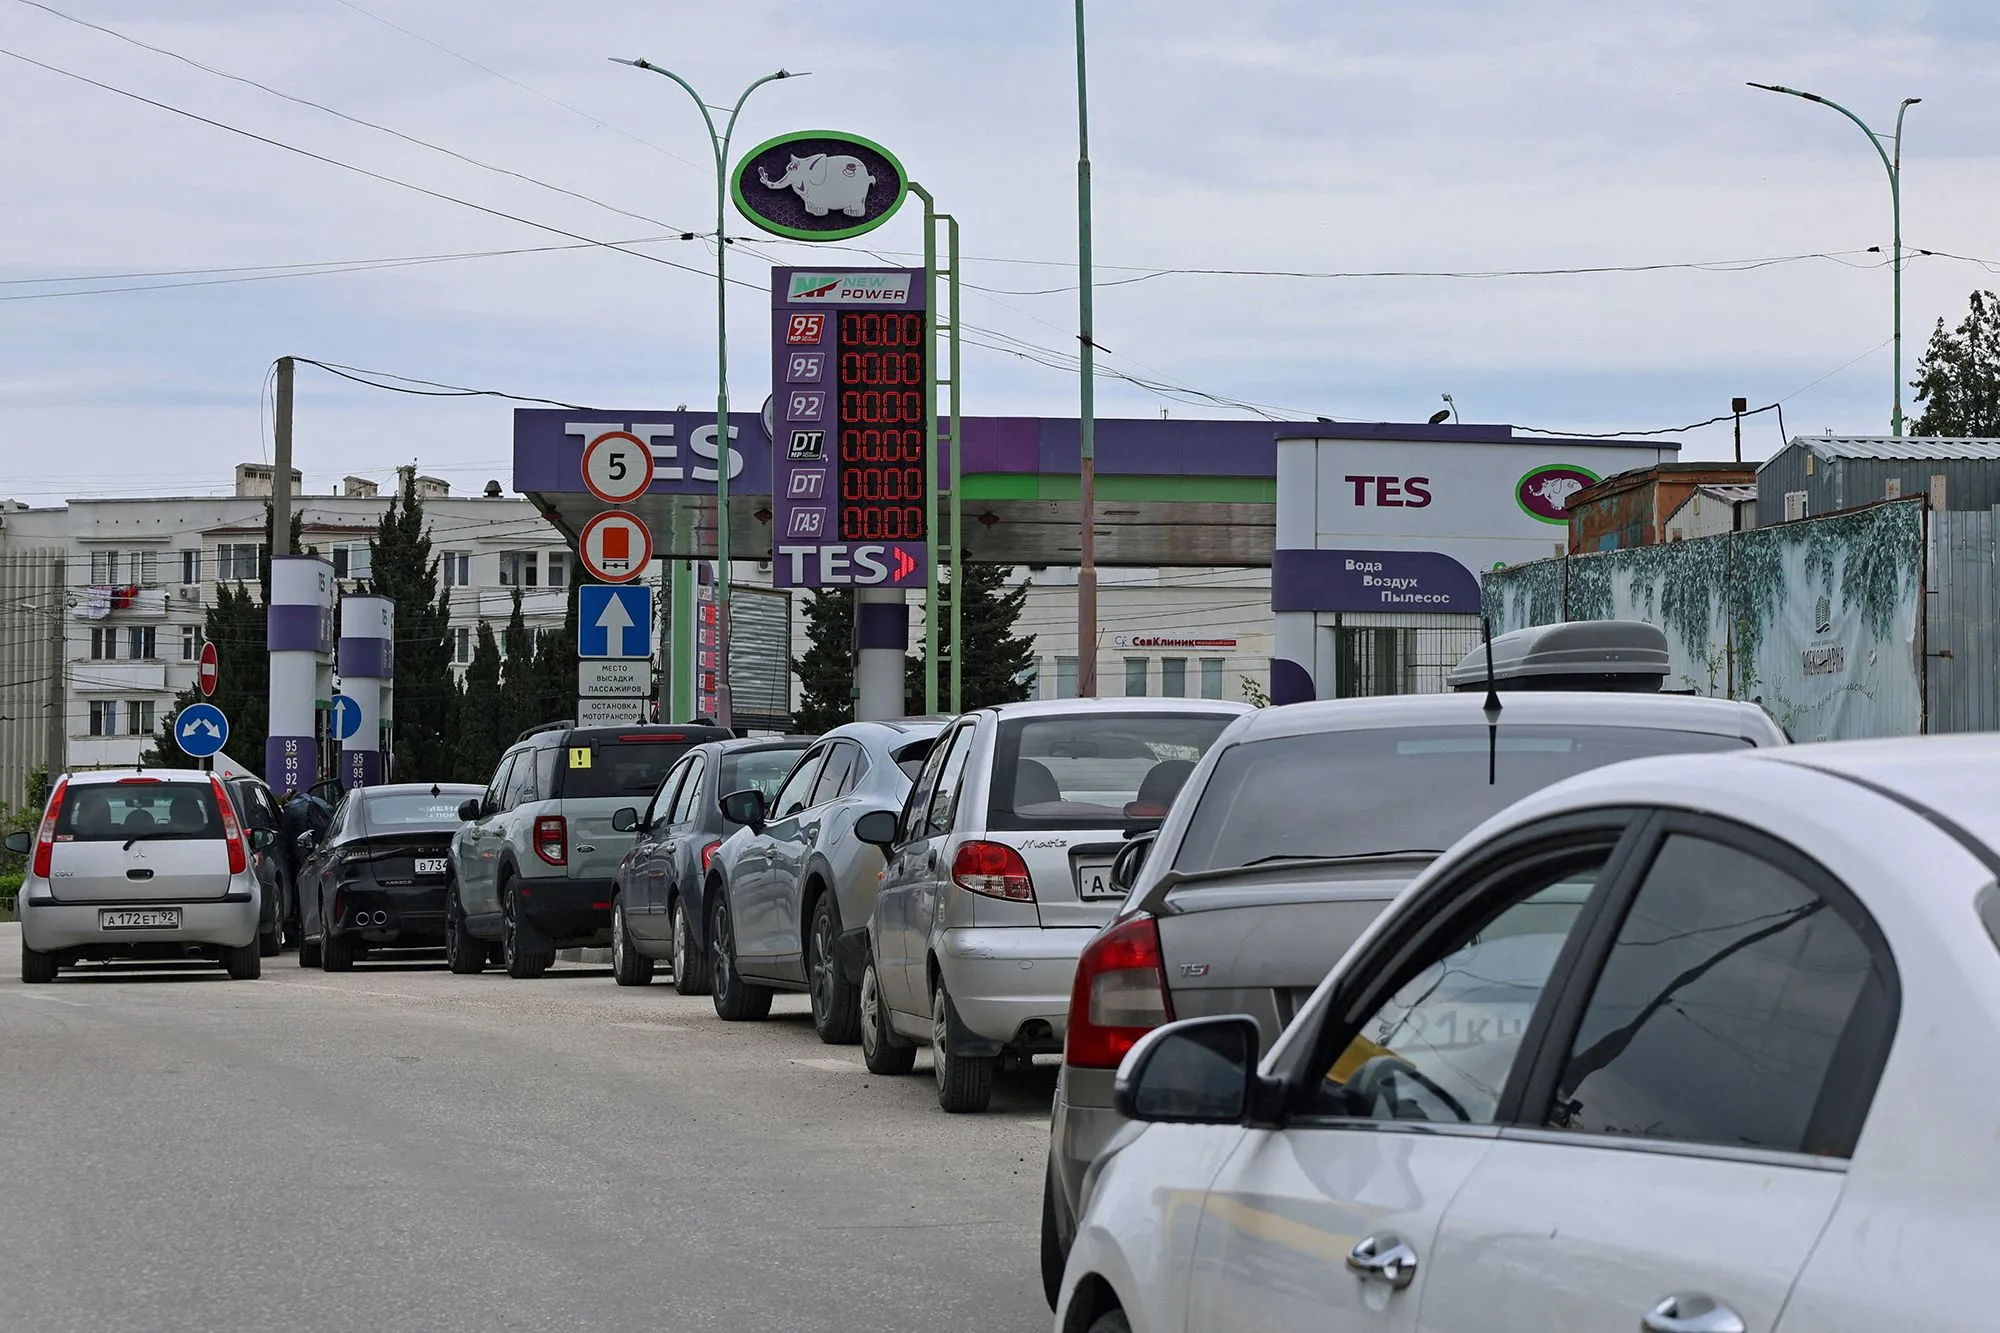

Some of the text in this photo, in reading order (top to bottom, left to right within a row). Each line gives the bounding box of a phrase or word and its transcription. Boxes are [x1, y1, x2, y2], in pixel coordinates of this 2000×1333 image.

[844, 277, 885, 287] NEW
[841, 290, 905, 299] POWER
[793, 317, 819, 336] 95
[793, 358, 819, 377] 95
[793, 397, 819, 415] 92
[792, 433, 821, 451] DT
[565, 423, 743, 481] TES
[609, 453, 627, 480] 5
[792, 475, 821, 493] DT
[1344, 475, 1432, 508] TES
[794, 513, 820, 531] ГАЗ
[779, 545, 888, 584] TES
[1345, 559, 1382, 572] Вода
[1363, 575, 1418, 589] Воздух
[1381, 591, 1450, 603] Пылесос
[285, 740, 297, 752] 95
[286, 757, 298, 770] 95
[353, 753, 364, 764] 95
[285, 772, 297, 785] 92
[353, 767, 364, 778] 95
[1017, 839, 1067, 850] Matiz
